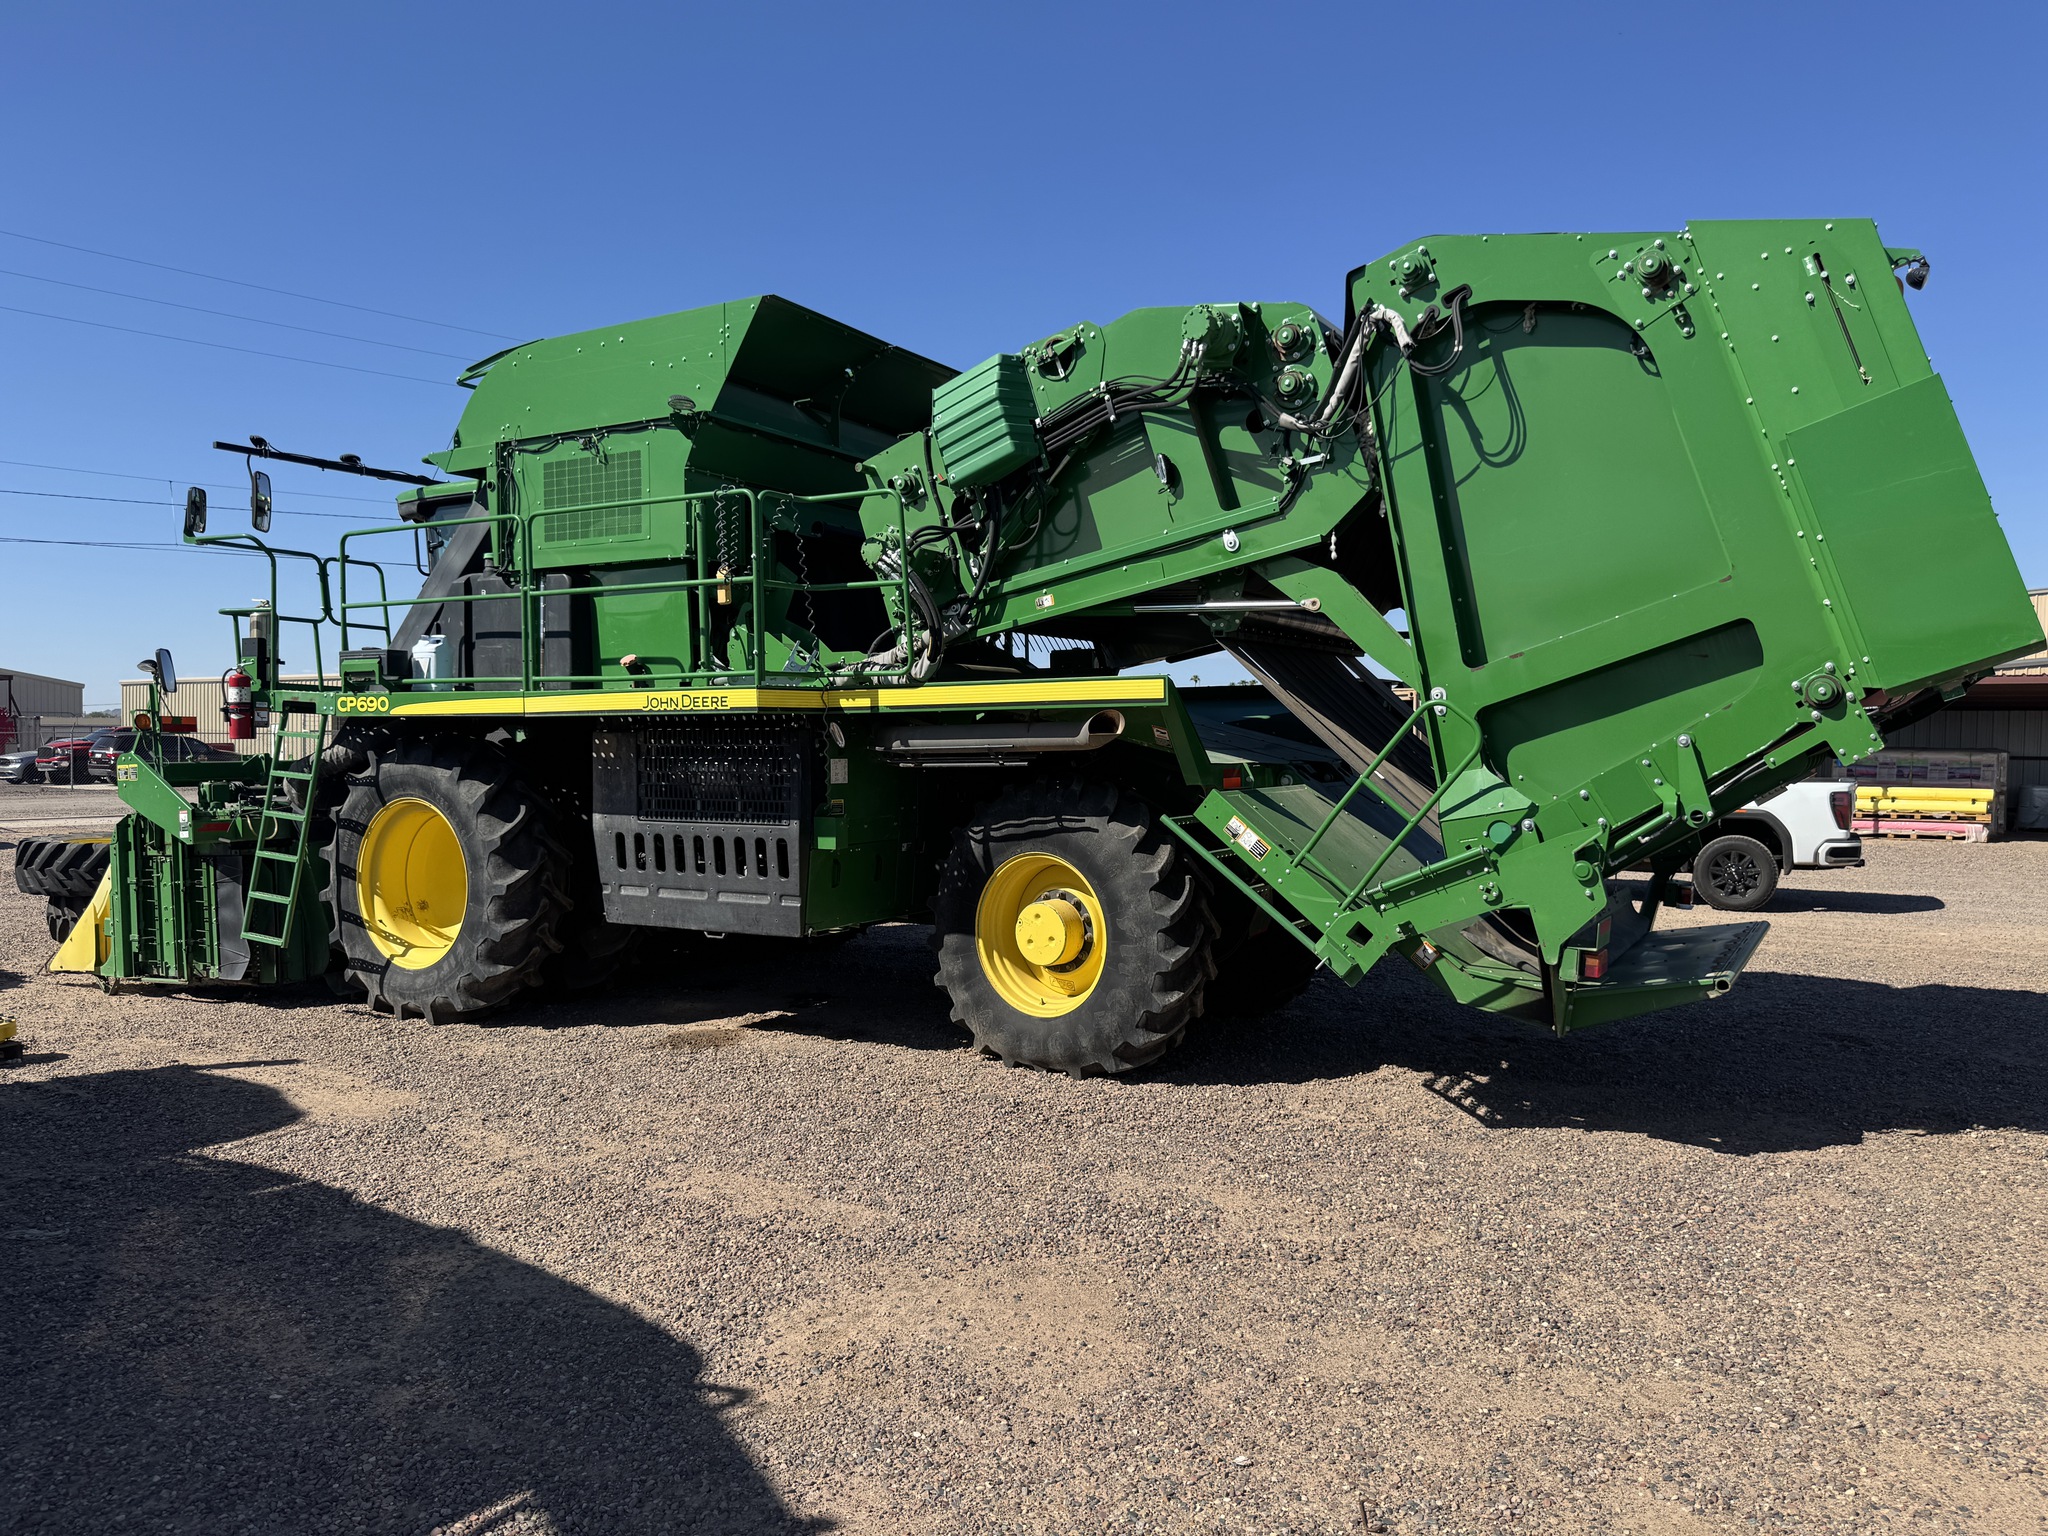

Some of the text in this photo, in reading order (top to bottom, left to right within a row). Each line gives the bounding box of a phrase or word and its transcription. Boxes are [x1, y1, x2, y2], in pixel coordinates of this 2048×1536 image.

[337, 696, 389, 712] CP690
[642, 694, 729, 709] JOHN DEERE
